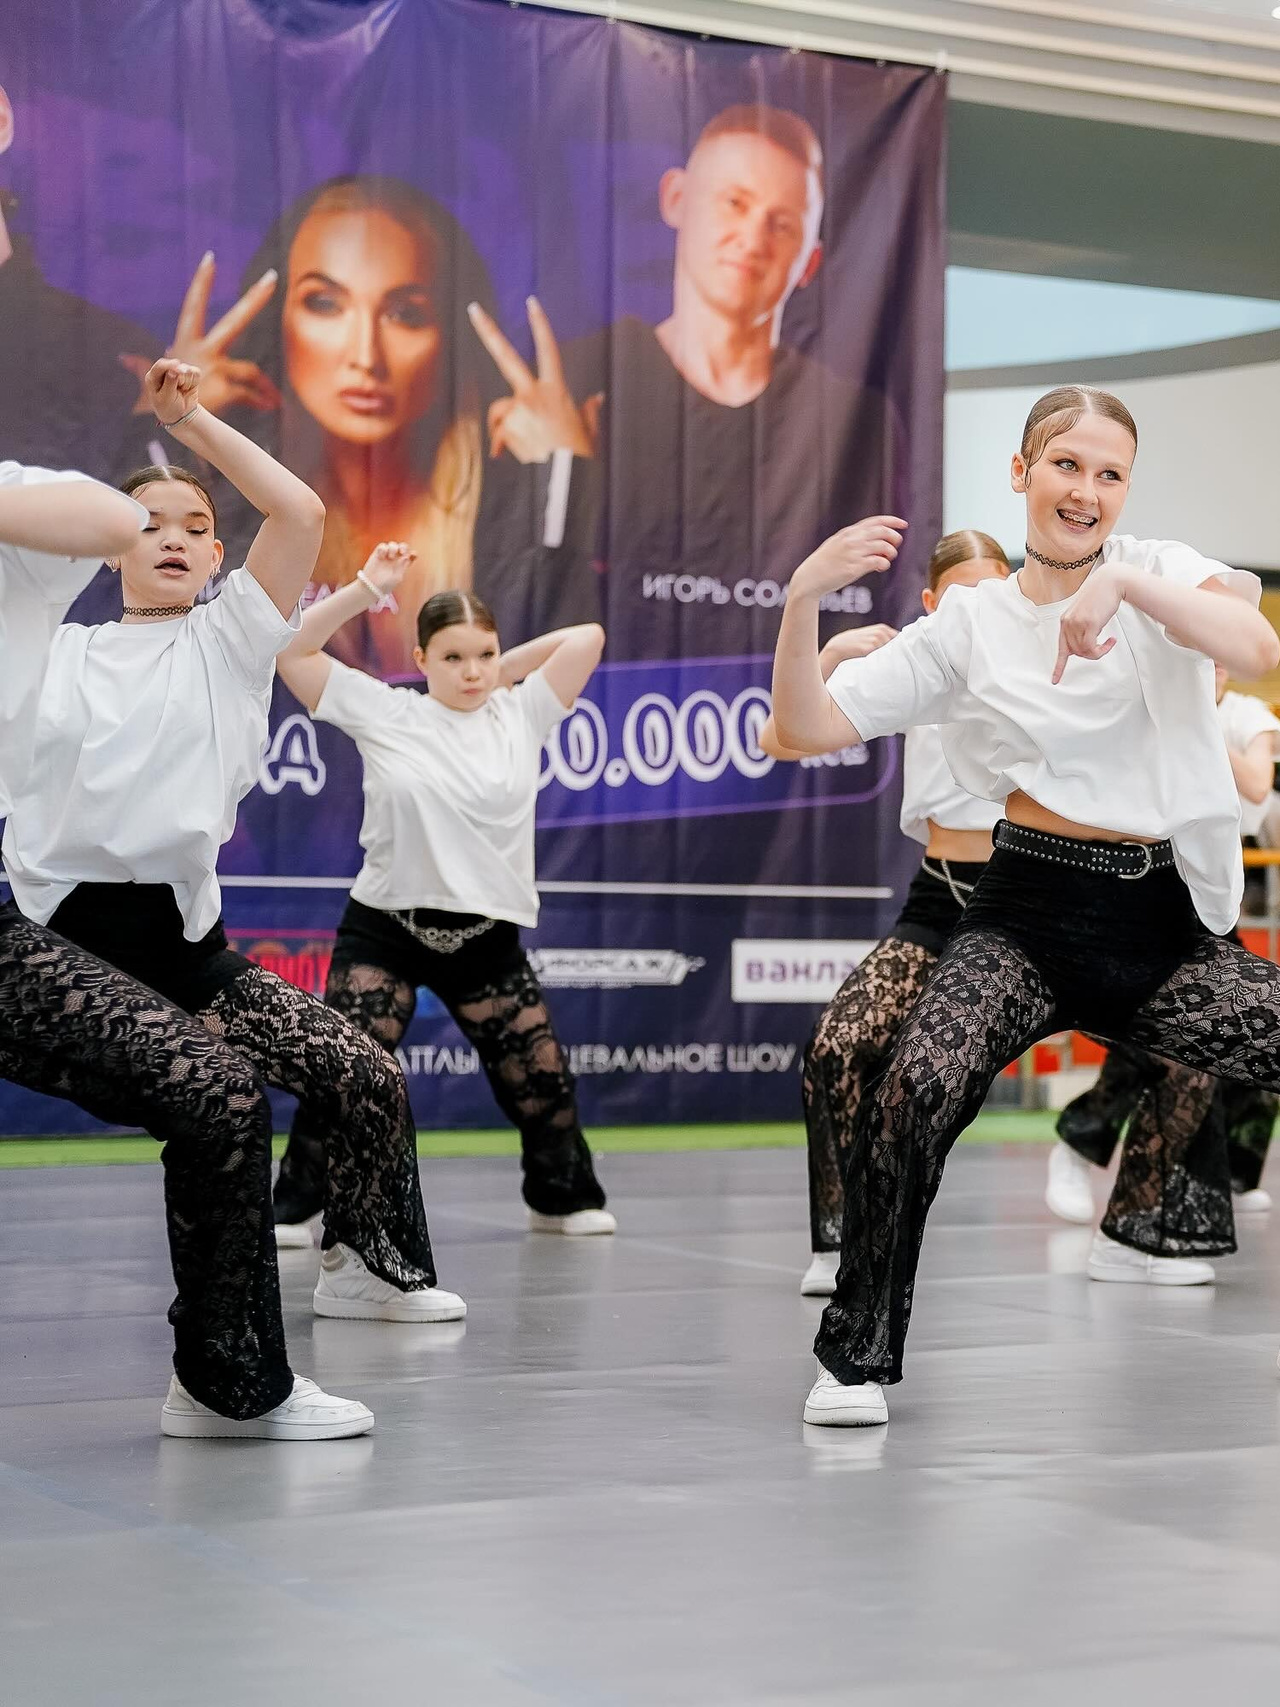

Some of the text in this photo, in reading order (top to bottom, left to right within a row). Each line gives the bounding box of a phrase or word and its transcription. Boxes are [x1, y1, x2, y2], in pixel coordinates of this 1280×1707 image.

[642, 573, 731, 605] ИГОРЬ
[534, 686, 777, 792] 0.000
[394, 1042, 797, 1076] АТТЛЫ ЦЕВАЛЬНОЕ ШОУ
